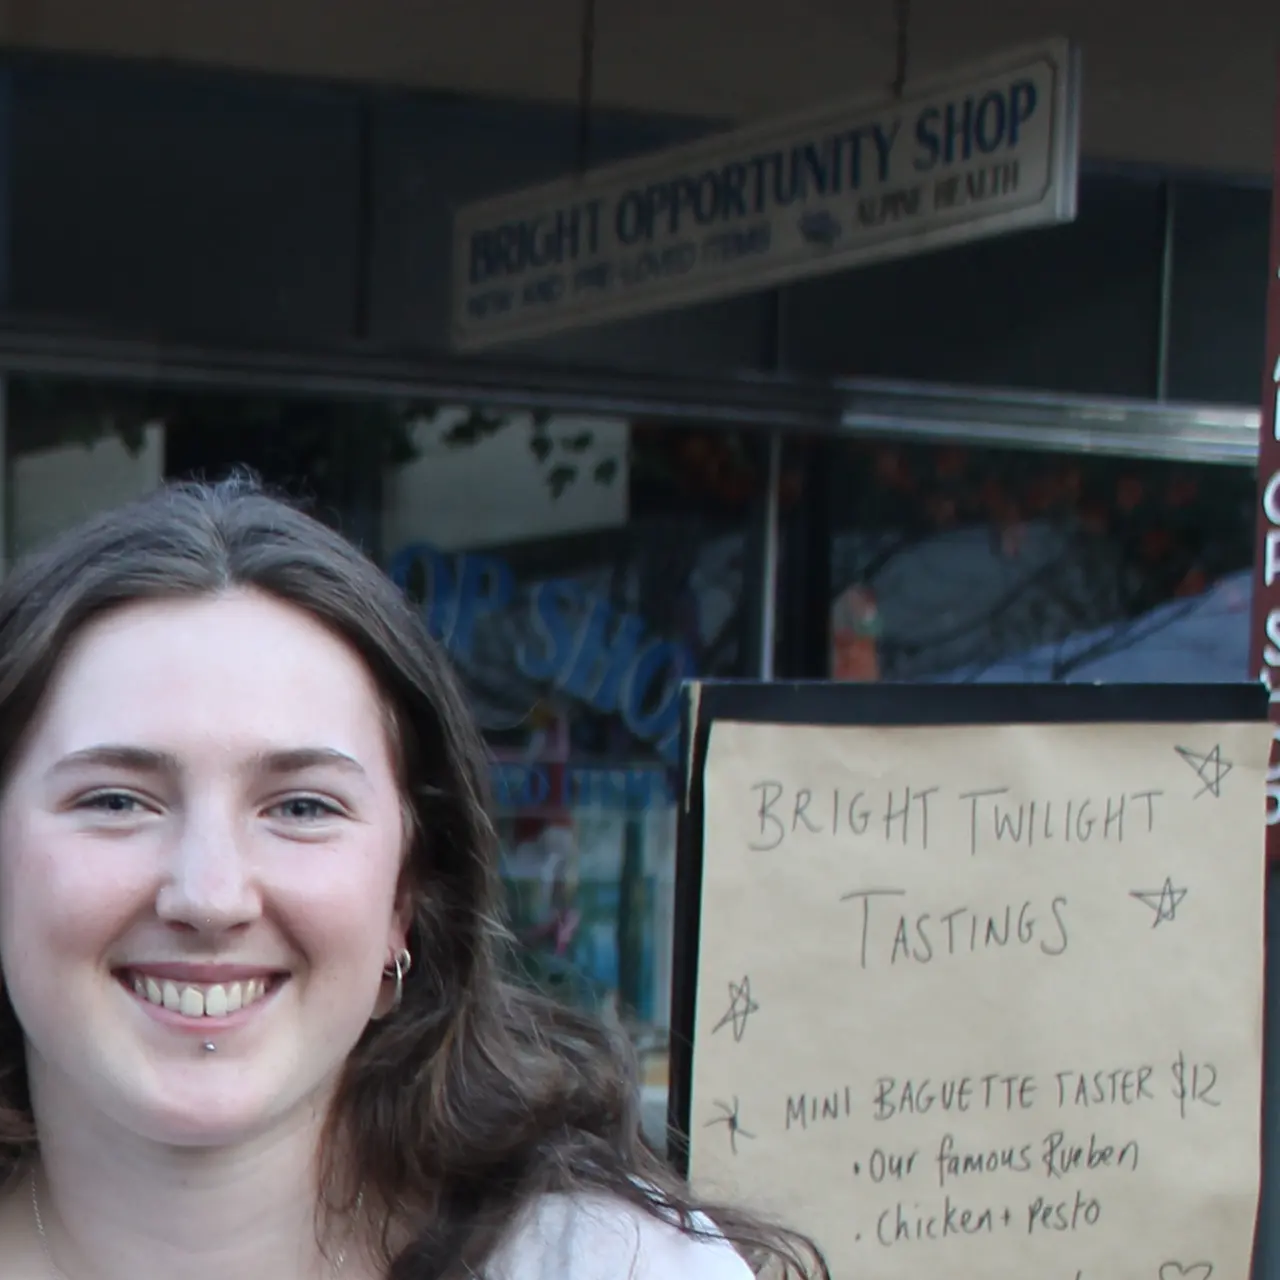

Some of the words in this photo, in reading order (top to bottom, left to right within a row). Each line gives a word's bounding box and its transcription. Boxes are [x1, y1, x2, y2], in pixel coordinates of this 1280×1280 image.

[470, 199, 601, 286] BRIGHT
[616, 119, 901, 247] OPPORTUNITY
[912, 77, 1038, 171] SHOP
[933, 160, 1020, 212] HEALTH
[516, 578, 698, 765] SHO
[749, 781, 939, 852] BRIGHT
[959, 786, 1165, 856] TWILIGHT
[840, 889, 1070, 969] TASTINGS
[785, 1093, 851, 1131] MINI
[873, 1073, 1038, 1122] BAGUETTE
[1055, 1065, 1155, 1101] TASTER
[1171, 1049, 1223, 1119] $12
[935, 1133, 1033, 1188] famous
